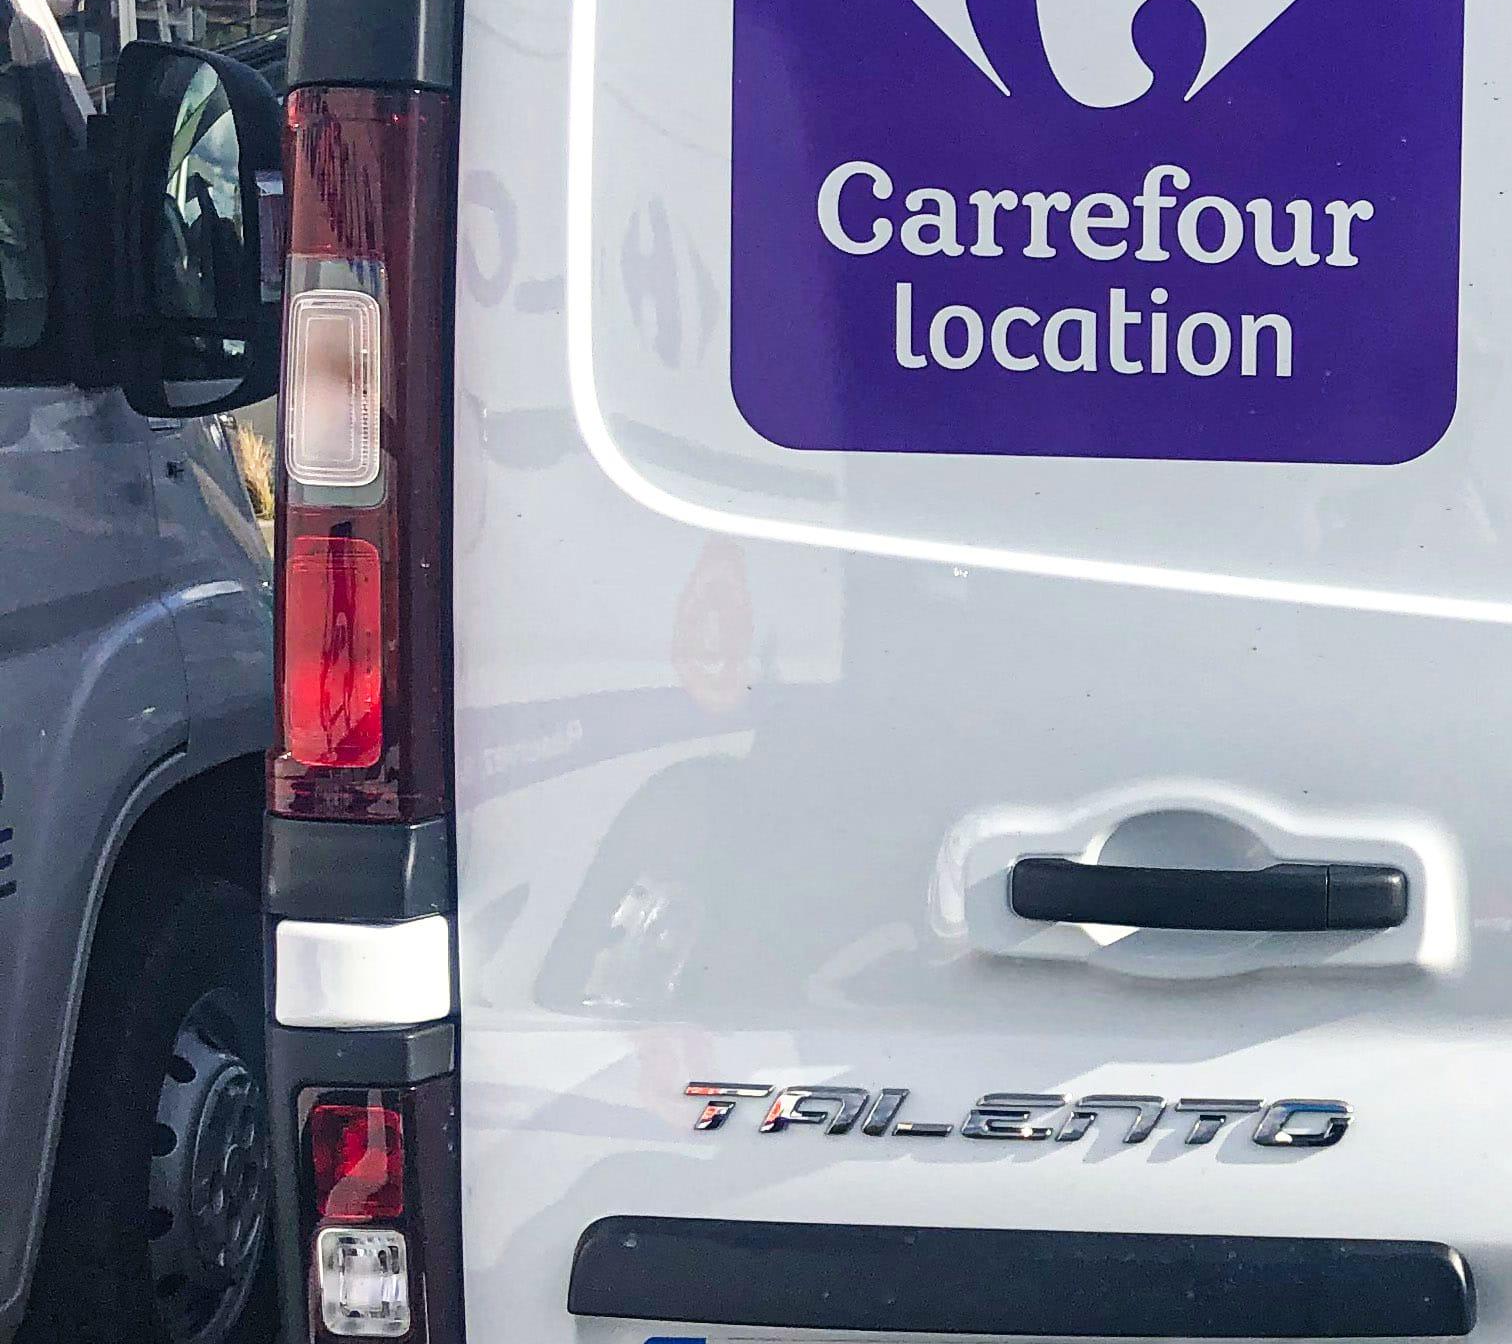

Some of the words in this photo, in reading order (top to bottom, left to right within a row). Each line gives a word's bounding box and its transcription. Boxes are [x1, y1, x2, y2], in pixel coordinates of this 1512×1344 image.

[817, 160, 1374, 267] Carrefour
[895, 282, 1293, 377] location
[684, 1080, 1355, 1148] TALENTO
